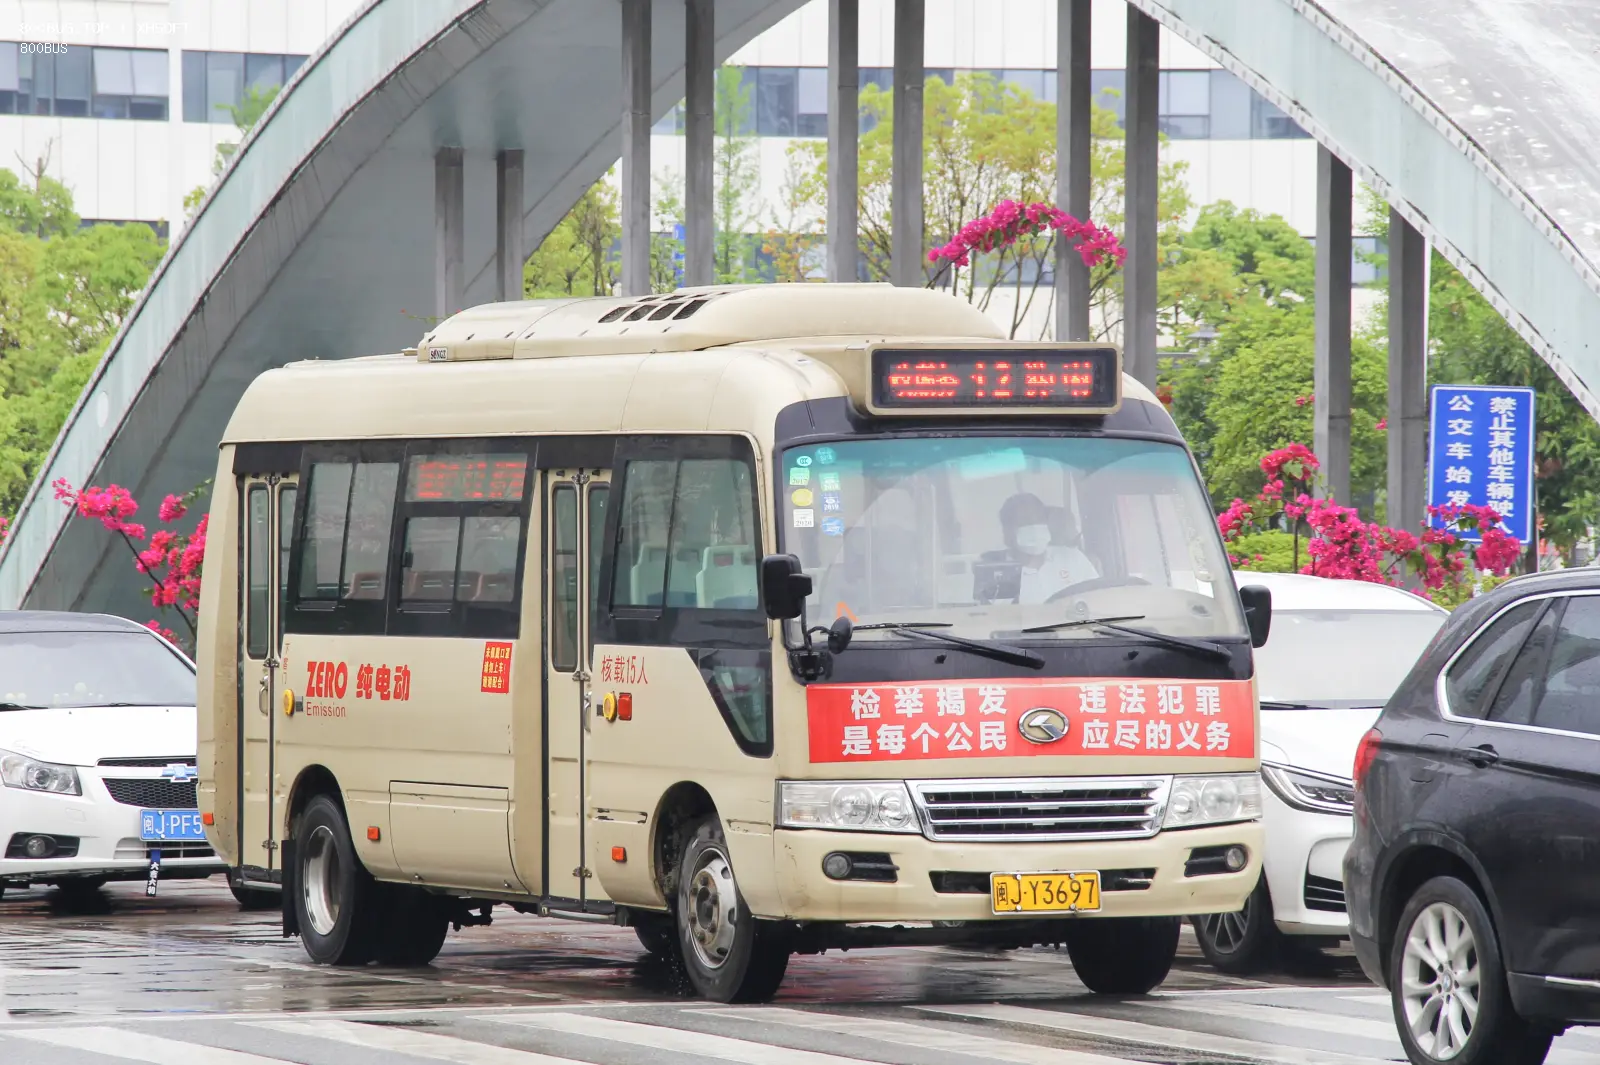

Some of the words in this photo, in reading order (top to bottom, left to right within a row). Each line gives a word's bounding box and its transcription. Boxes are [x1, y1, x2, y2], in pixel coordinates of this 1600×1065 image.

[306, 661, 348, 699] ZERO
[356, 663, 410, 701] 纯电动
[601, 654, 648, 684] 核载15人
[306, 702, 346, 717] Emission
[851, 687, 1007, 720] 检举揭发
[1079, 684, 1221, 715] 违法犯罪
[841, 721, 1007, 756] 是每个公民
[1082, 719, 1230, 750] 应尽的义务
[996, 877, 1095, 906] 闽J·Y3697
